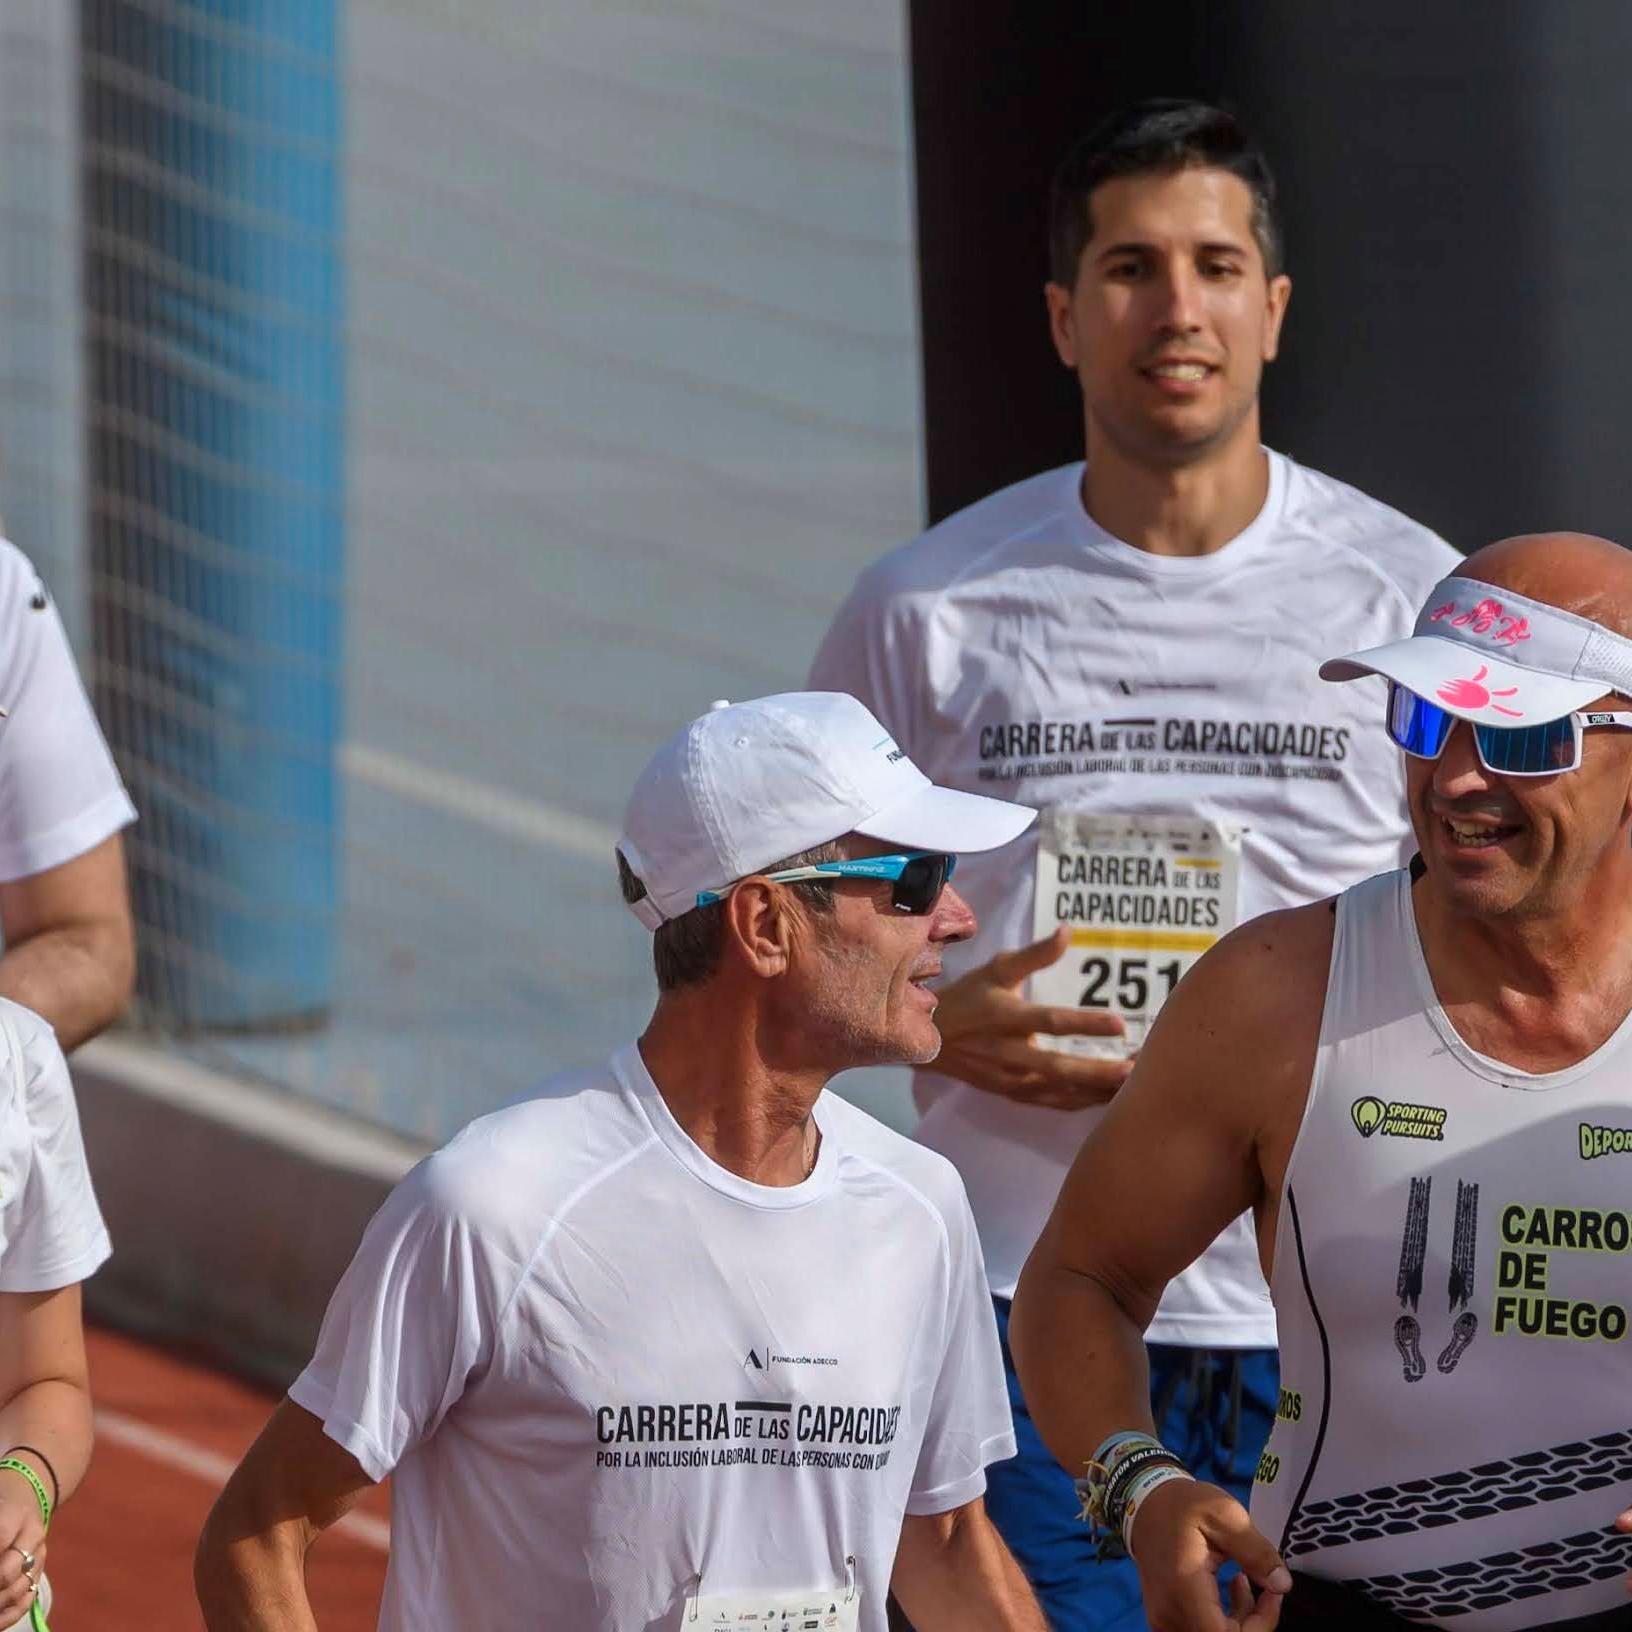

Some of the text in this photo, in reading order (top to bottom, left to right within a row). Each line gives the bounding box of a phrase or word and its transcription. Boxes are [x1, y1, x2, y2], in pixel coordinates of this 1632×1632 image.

[979, 718, 1351, 761] CARRERA DE LAS CAPACIDADES
[1057, 855, 1221, 890] CARRERA DE LAS
[1056, 891, 1219, 927] CAPACIDADES
[1386, 1102, 1447, 1124] SPORTING
[1497, 1251, 1547, 1290] DE
[1494, 1296, 1627, 1340] FUEGO
[771, 1355, 812, 1365] FUNDACIÓN
[597, 1402, 730, 1444] CARRERA
[734, 1416, 753, 1438] DE
[758, 1415, 790, 1440] LAS
[596, 1450, 622, 1468] POR
[625, 1451, 641, 1467] LA
[644, 1447, 709, 1468] INCLUSIÓN
[711, 1447, 758, 1466] LABORAL
[762, 1448, 779, 1465] DE
[781, 1450, 801, 1467] LAS
[801, 1450, 852, 1468] PERSONAS
[852, 1453, 875, 1470] CON
